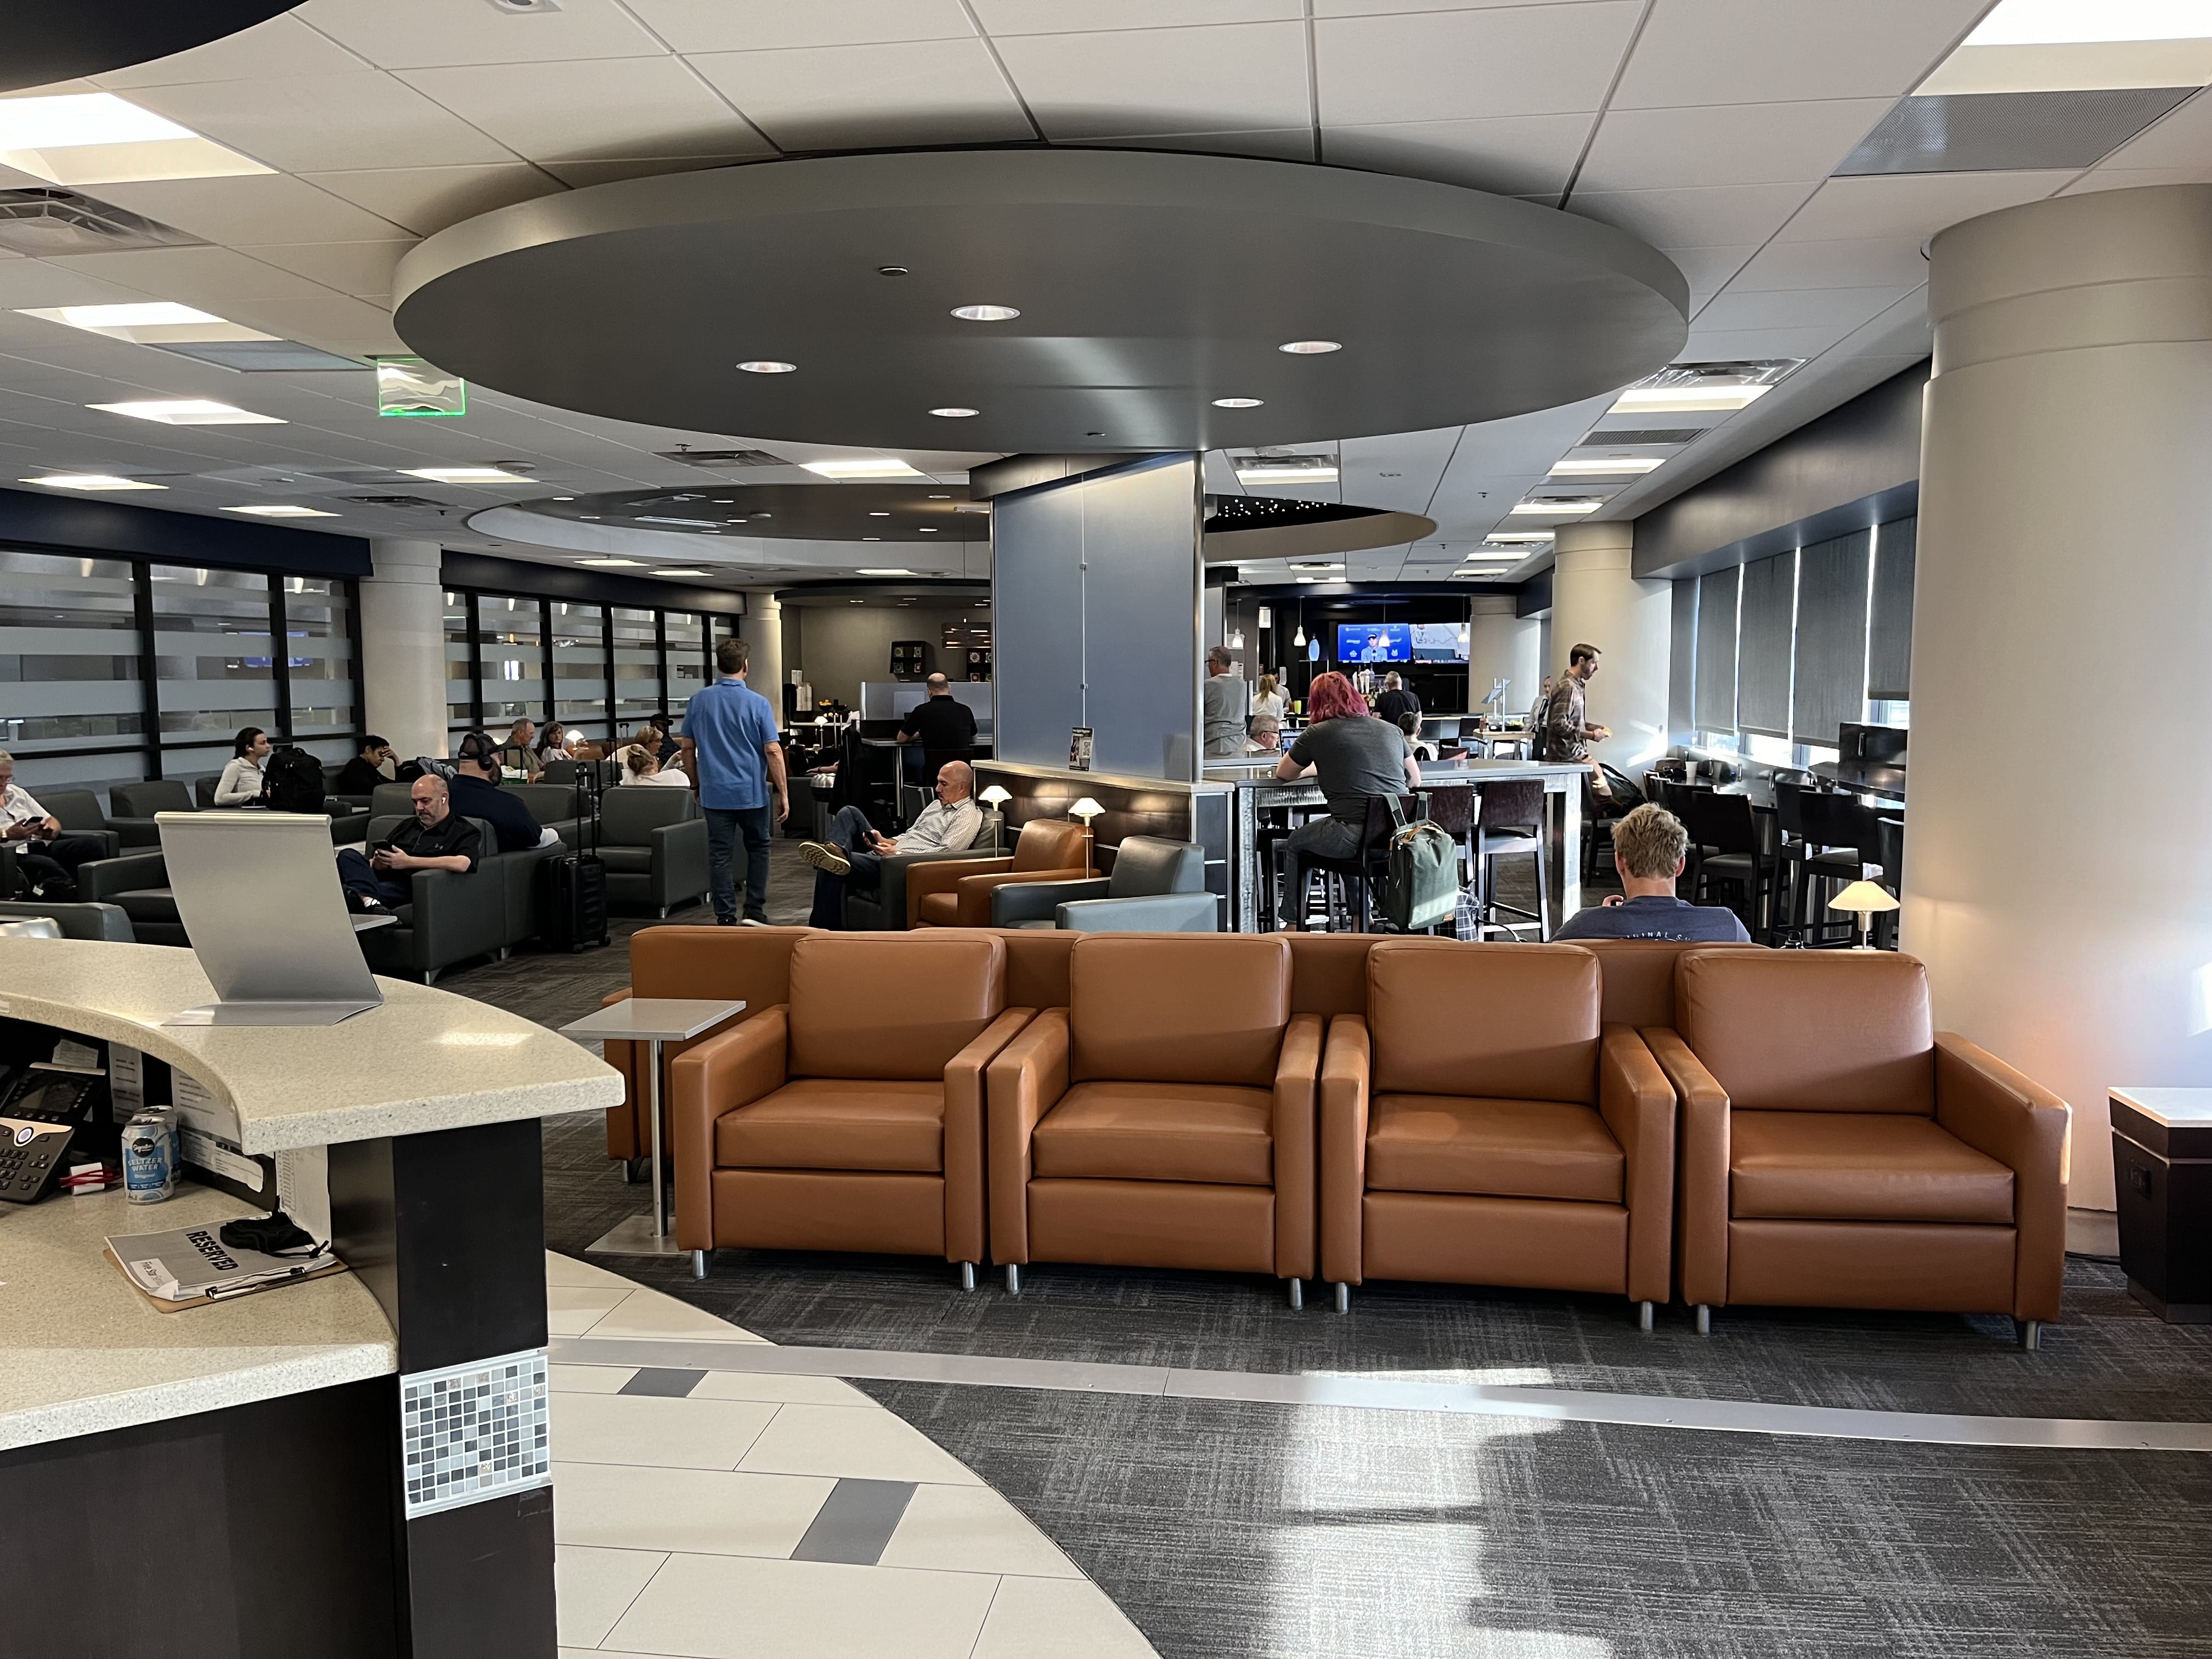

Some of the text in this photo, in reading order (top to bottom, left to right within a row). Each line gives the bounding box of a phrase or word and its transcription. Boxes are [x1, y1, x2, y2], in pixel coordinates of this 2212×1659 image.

[127, 1157, 162, 1166] SELTZER
[132, 1164, 159, 1172] WATER
[186, 1231, 239, 1271] RESERVED
